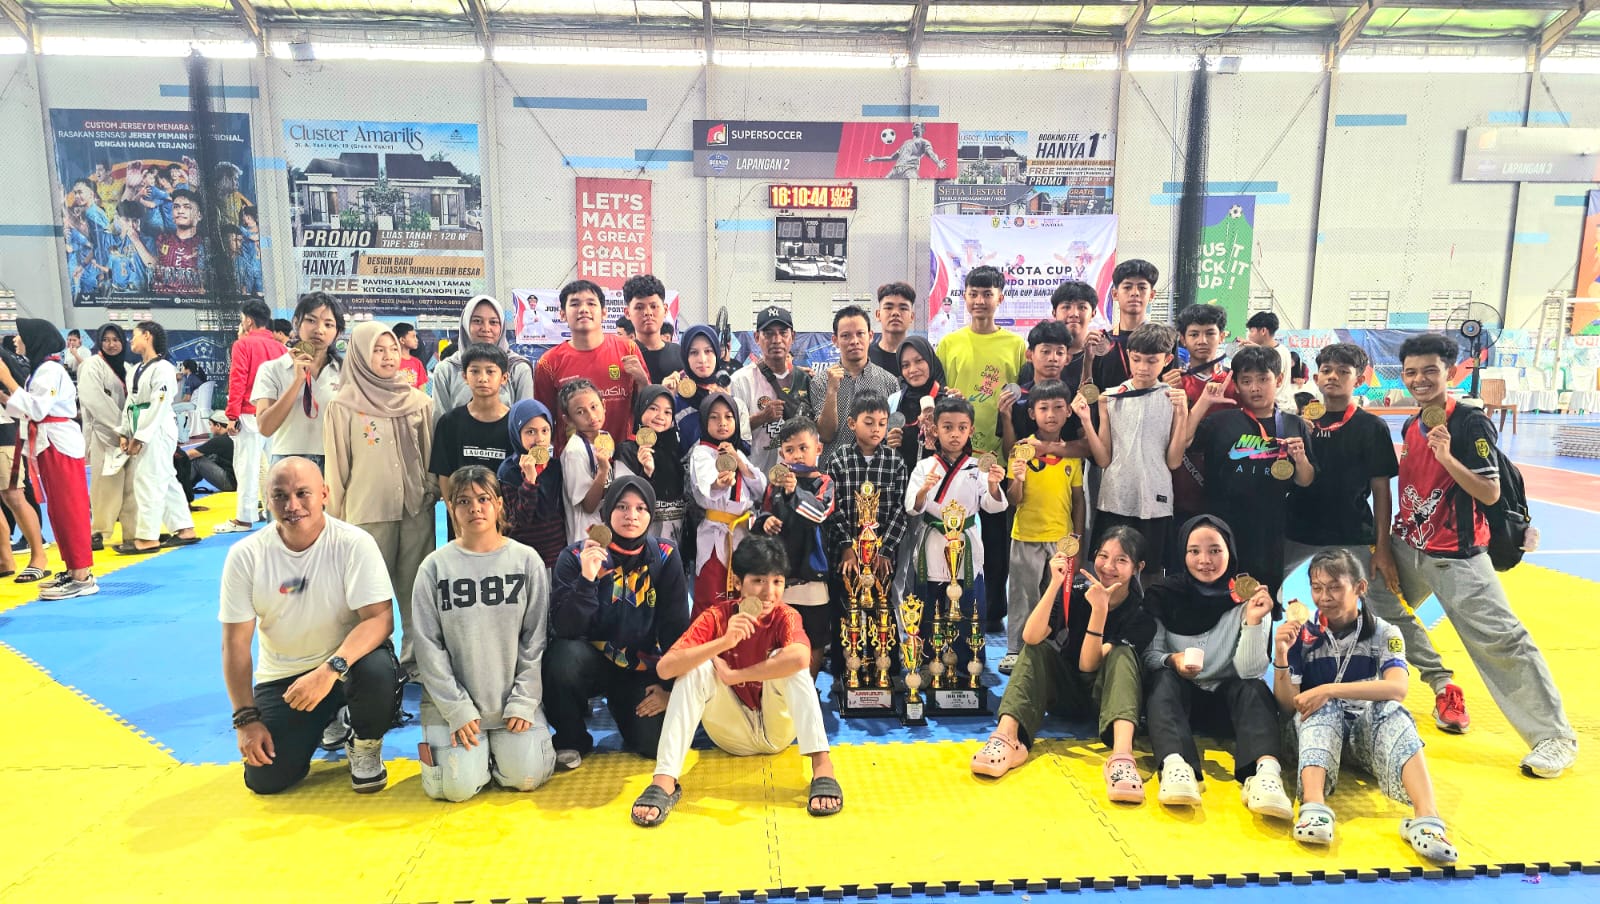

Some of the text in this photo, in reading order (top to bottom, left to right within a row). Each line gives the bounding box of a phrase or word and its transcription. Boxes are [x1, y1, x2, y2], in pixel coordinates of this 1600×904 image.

[84, 121, 117, 129] CUSTOM
[119, 122, 146, 130] JERSEY
[157, 123, 190, 131] MENARA
[58, 130, 95, 138] RASAKAN
[95, 131, 127, 139] SENSASI
[128, 131, 156, 139] JERSEY
[157, 132, 187, 140] PEMAIN
[289, 124, 424, 151] Cluster Amarilis
[731, 130, 803, 140] SUPERSOCCER
[1038, 133, 1080, 141] BOOKING FEE
[94, 140, 127, 148] DENGAN
[128, 141, 156, 149] HARGA
[1036, 142, 1085, 158] HANYA
[736, 158, 791, 170] LAPANGAN 2
[1502, 162, 1545, 175] LAPANGAN
[1028, 167, 1055, 175] FREE
[1029, 176, 1063, 186] PROMO
[582, 192, 643, 211] LET'S
[772, 187, 828, 207] 16:10:44
[582, 212, 646, 230] MAKE
[303, 230, 371, 247] PROMO
[381, 231, 403, 239] LUAS
[404, 232, 432, 240] TANAH
[440, 232, 457, 241] 120
[582, 231, 645, 244] A GREAT
[382, 239, 400, 247] TIPE
[328, 250, 338, 258] FEE
[582, 245, 646, 261] GOALS
[367, 256, 413, 265] DESIGN BARU
[380, 266, 407, 274] LUASAN
[409, 266, 434, 275] RUMAH
[436, 267, 456, 275] LEBIH
[458, 267, 481, 276] BESAR
[582, 261, 646, 278] HERE!
[1008, 266, 1042, 275] KOTA
[1046, 266, 1072, 276] CUP
[1230, 260, 1249, 275] IT
[310, 278, 359, 292] FREE
[1197, 274, 1223, 289] UP
[363, 286, 398, 294] KITCHEN
[1020, 289, 1033, 297] CUP
[465, 450, 504, 459] LAUGHTER
[437, 573, 525, 611] 1987
